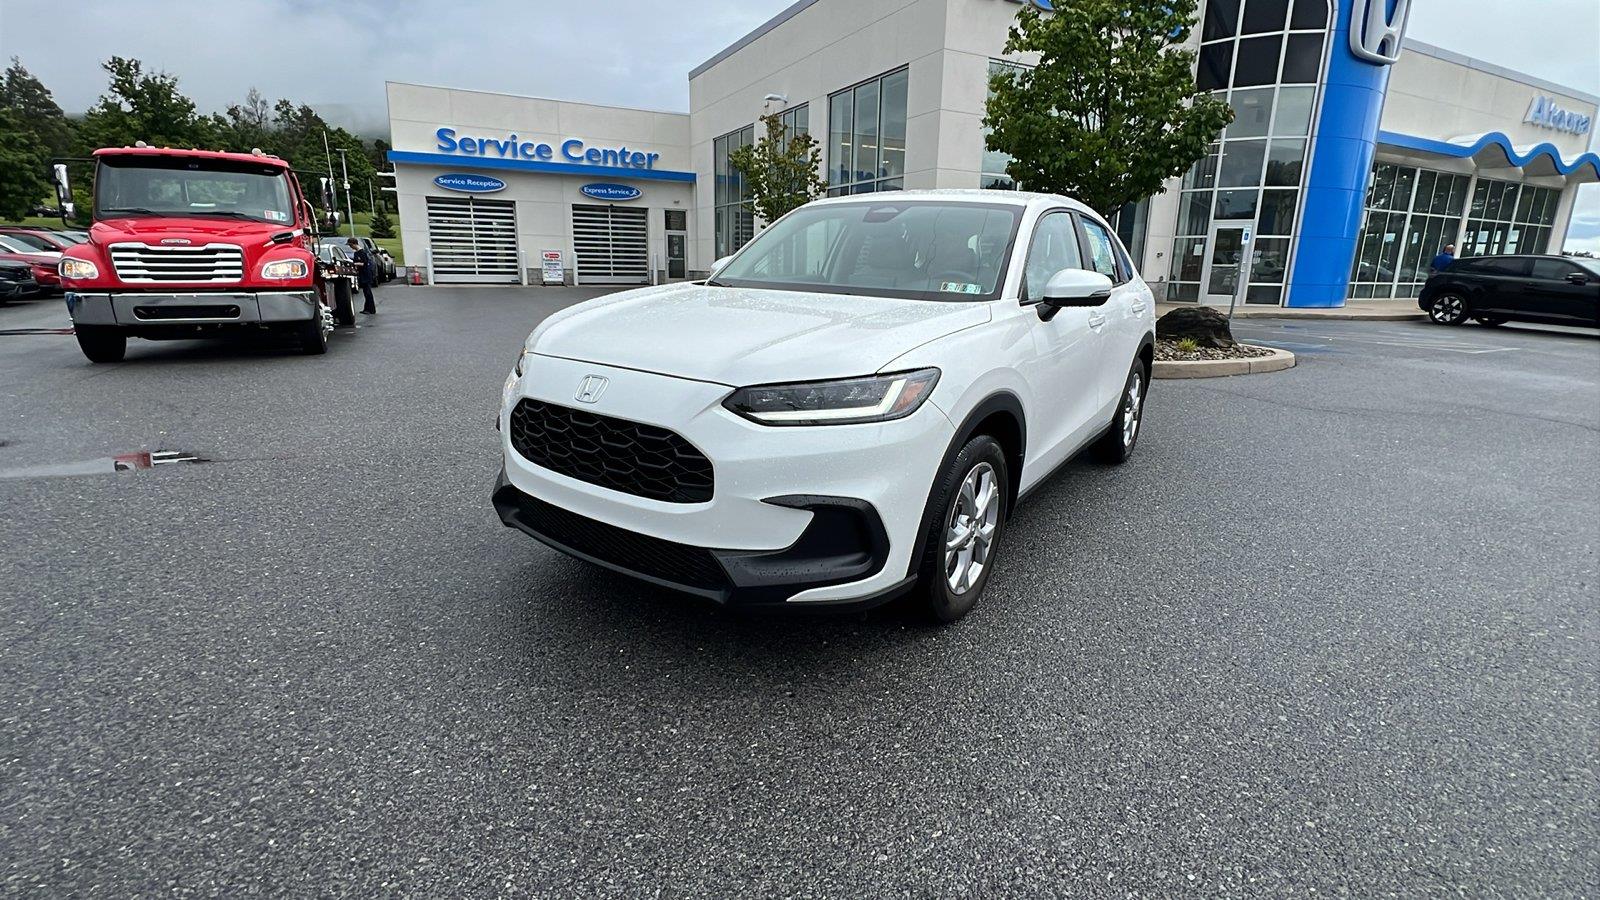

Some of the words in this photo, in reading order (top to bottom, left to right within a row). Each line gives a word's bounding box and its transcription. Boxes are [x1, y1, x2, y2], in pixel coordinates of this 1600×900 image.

[436, 128, 553, 160] Service
[561, 139, 659, 168] Center
[438, 177, 466, 185] Service
[467, 179, 502, 187] Reception
